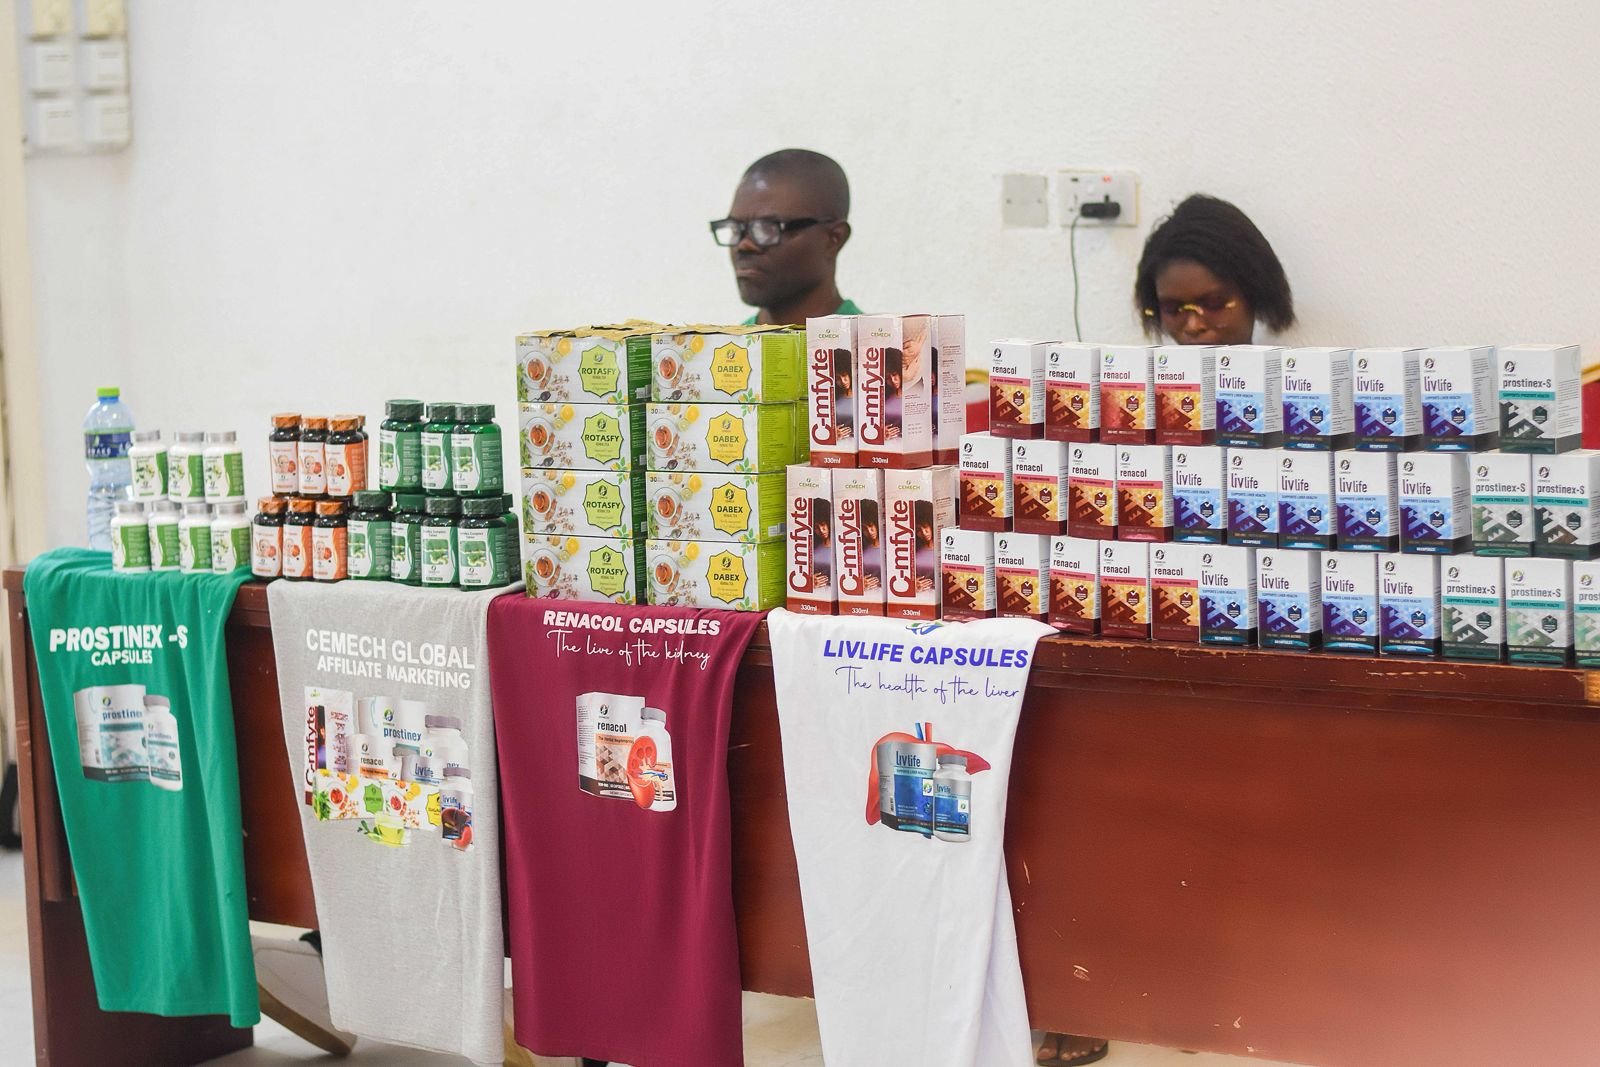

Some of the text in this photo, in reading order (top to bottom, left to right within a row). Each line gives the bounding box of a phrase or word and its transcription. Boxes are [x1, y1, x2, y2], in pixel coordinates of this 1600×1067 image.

[717, 365, 743, 373] DABEX
[992, 366, 1017, 375] renacol
[1049, 370, 1075, 379] renacol
[1103, 371, 1131, 380] renacol
[1157, 372, 1185, 381] renacol
[1219, 373, 1246, 390] livlife
[1285, 376, 1312, 391] livlife
[1356, 376, 1384, 392] livlife
[1424, 375, 1452, 392] livlife
[1503, 378, 1552, 389] prostinex-S
[811, 348, 836, 446] C-mfyte
[860, 346, 884, 446] C-mfyte
[585, 434, 619, 443] ROTASFY
[713, 435, 739, 443] DABEX
[962, 460, 989, 469] renacol
[1016, 464, 1043, 473] renacol
[1072, 466, 1099, 476] renacol
[1120, 469, 1147, 478] renacol
[1176, 470, 1202, 486] livlife
[1231, 472, 1259, 489] livlife
[1281, 475, 1309, 491] livlife
[1339, 477, 1367, 493] livlife
[1402, 478, 1432, 495] livlife
[1476, 483, 1526, 493] prostinex-S
[1537, 484, 1585, 494] prostinex-S
[586, 501, 620, 509] ROTASFY
[717, 505, 743, 513] DABEX
[789, 496, 813, 593] C-mfyte
[838, 498, 864, 596] C-mfyte
[889, 499, 916, 598] C-mfyte
[944, 553, 970, 562] renacol
[998, 557, 1024, 565] renacol
[1053, 559, 1080, 569] renacol
[1103, 565, 1130, 574] renacol
[590, 567, 624, 576] ROTASFY
[713, 573, 739, 581] DABEX
[1154, 567, 1183, 576] renacol
[1201, 570, 1229, 586] livlife
[1261, 573, 1289, 590] livlife
[1325, 575, 1355, 592] livlife
[1383, 578, 1413, 595] livlife
[1446, 584, 1496, 594] prostinex-S
[1511, 588, 1561, 598] prostinex-S
[800, 604, 818, 612] 330ml
[902, 609, 921, 617] 330ml
[543, 610, 721, 636] RENACOL CAPSULES
[50, 625, 188, 652] PROSTINEX -S
[306, 628, 475, 670] CEMECH GLOBAL
[547, 628, 581, 657] The
[618, 642, 632, 666] of
[632, 638, 660, 665] the
[665, 640, 711, 670] kidney
[823, 639, 1029, 668] LIVLIFE CAPSULES
[91, 650, 153, 666] CAPSULES
[317, 655, 471, 689] AFFILIATE MARKETING
[835, 665, 1020, 704] The health of the liver
[597, 722, 627, 733] renacol
[383, 727, 421, 742] prostinex
[360, 757, 384, 766] renacol
[896, 750, 921, 767] livlife
